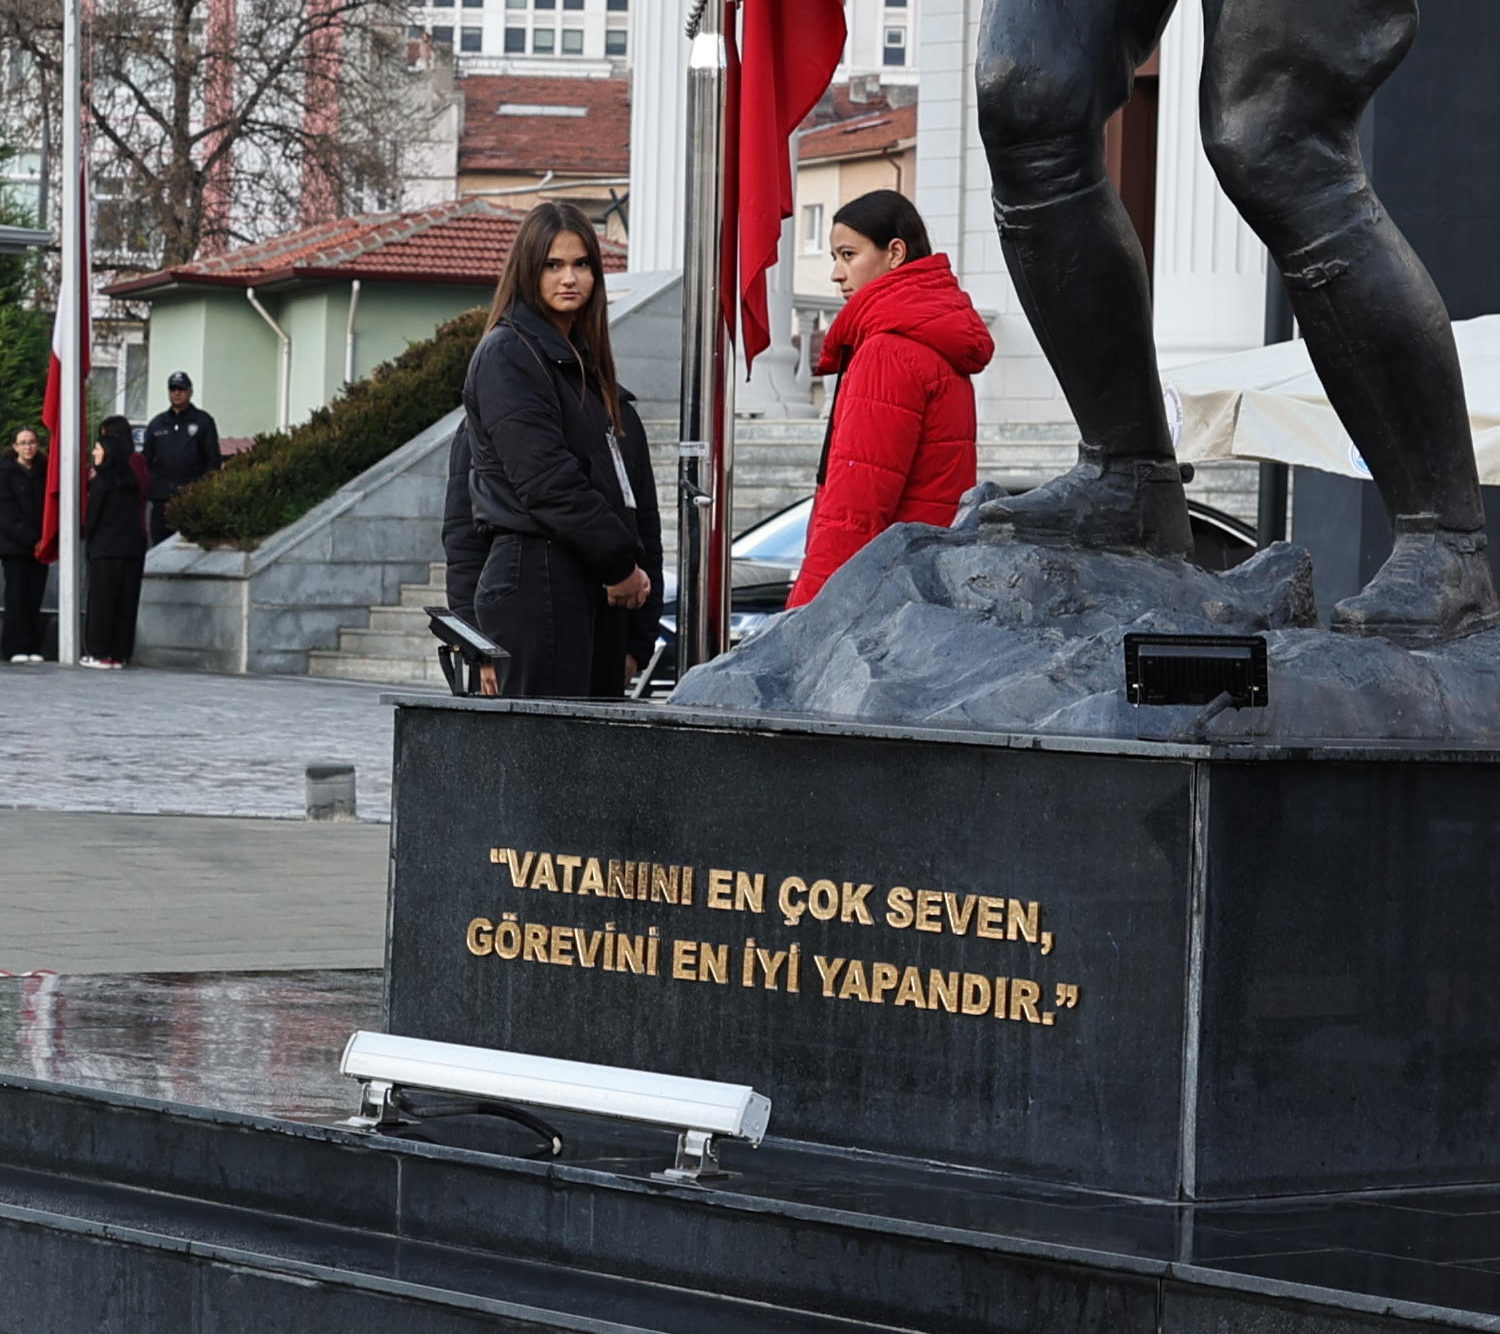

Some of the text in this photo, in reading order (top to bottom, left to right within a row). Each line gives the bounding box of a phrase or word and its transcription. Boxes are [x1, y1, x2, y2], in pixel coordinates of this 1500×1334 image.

[465, 911, 662, 977] GÖREVİNİ
[671, 938, 730, 985] EN
[741, 936, 802, 994] İYİ
[706, 868, 767, 914] EN
[777, 875, 876, 927] ÇOK
[885, 884, 1055, 956] SEVEN,
